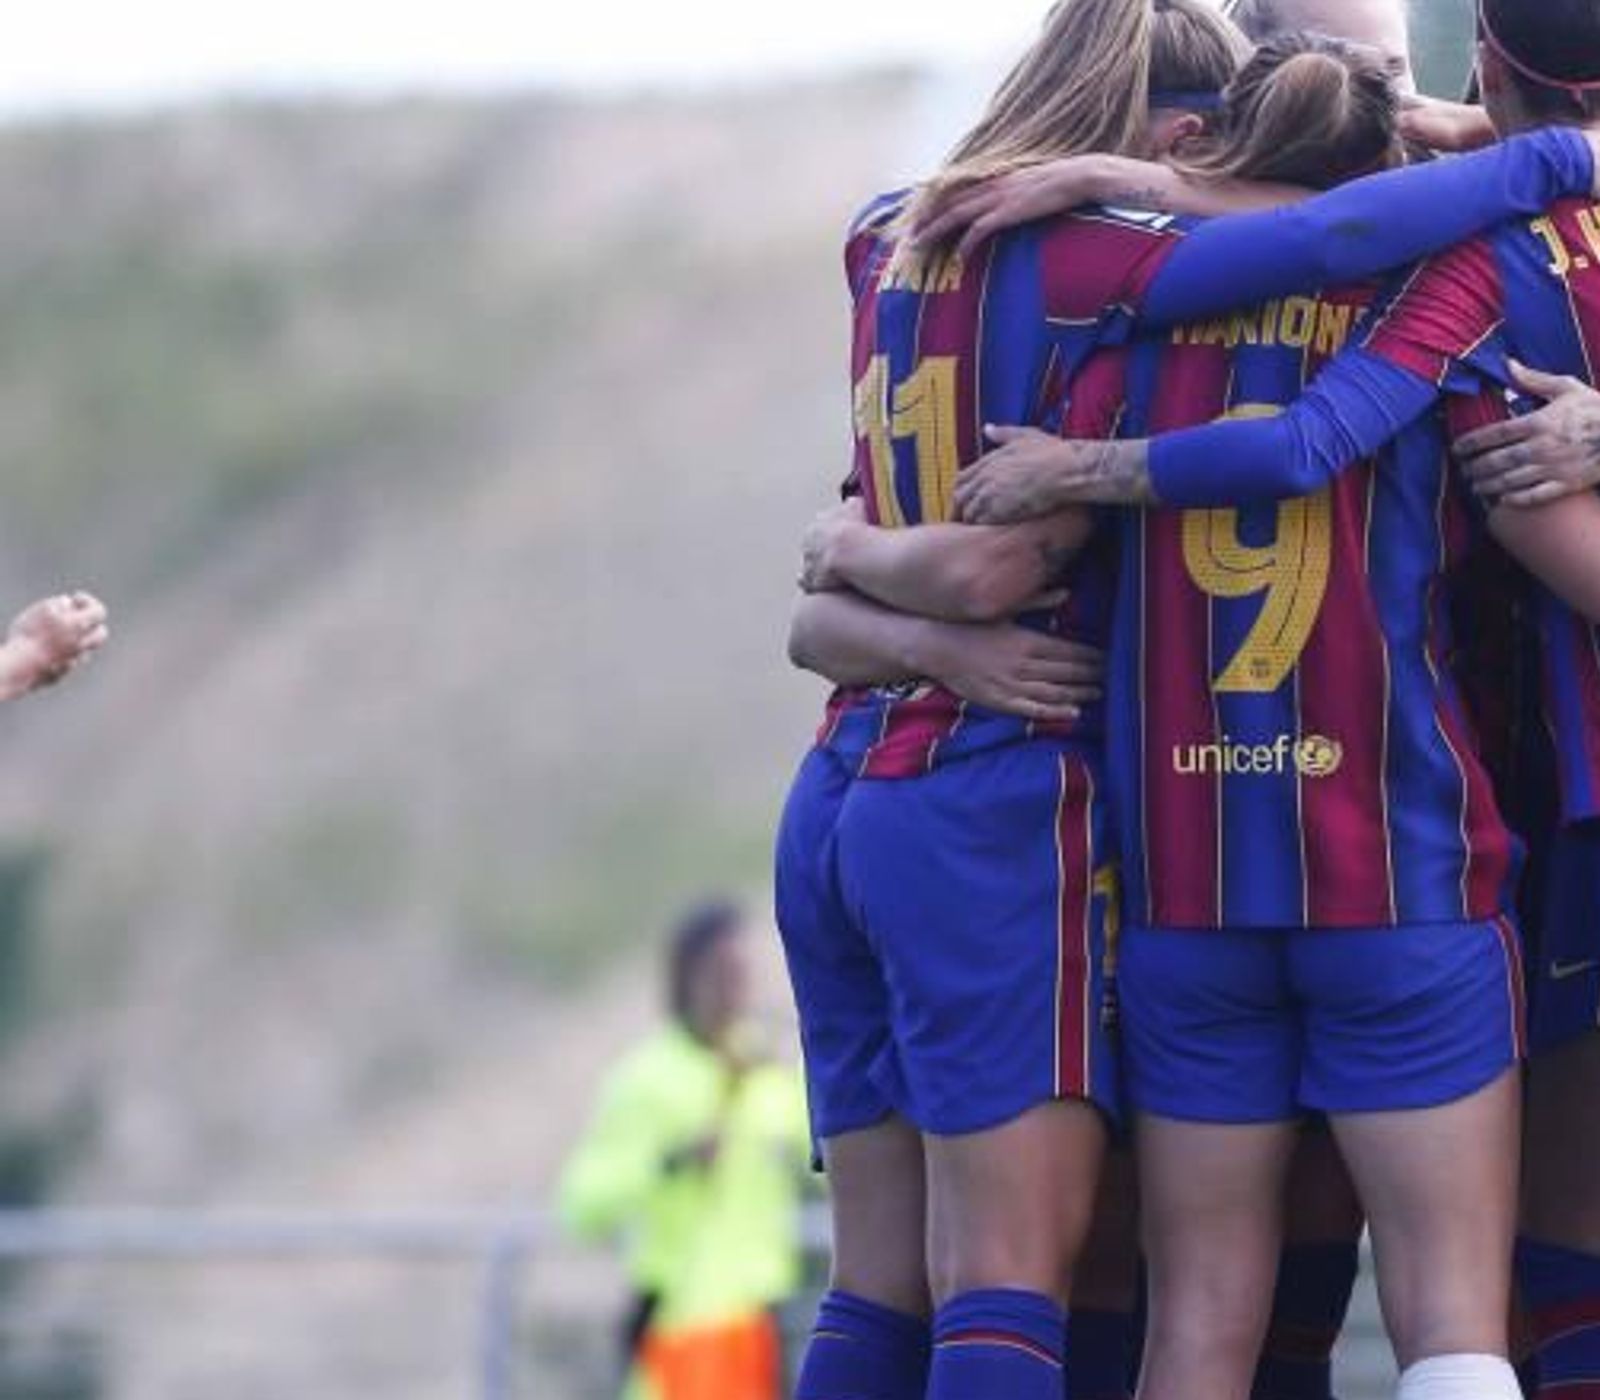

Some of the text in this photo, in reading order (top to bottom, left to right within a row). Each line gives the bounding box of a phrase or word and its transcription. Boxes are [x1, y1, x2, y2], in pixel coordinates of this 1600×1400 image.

[854, 354, 958, 528] 11
[1182, 402, 1332, 691] 9
[1172, 734, 1290, 775] unicef
